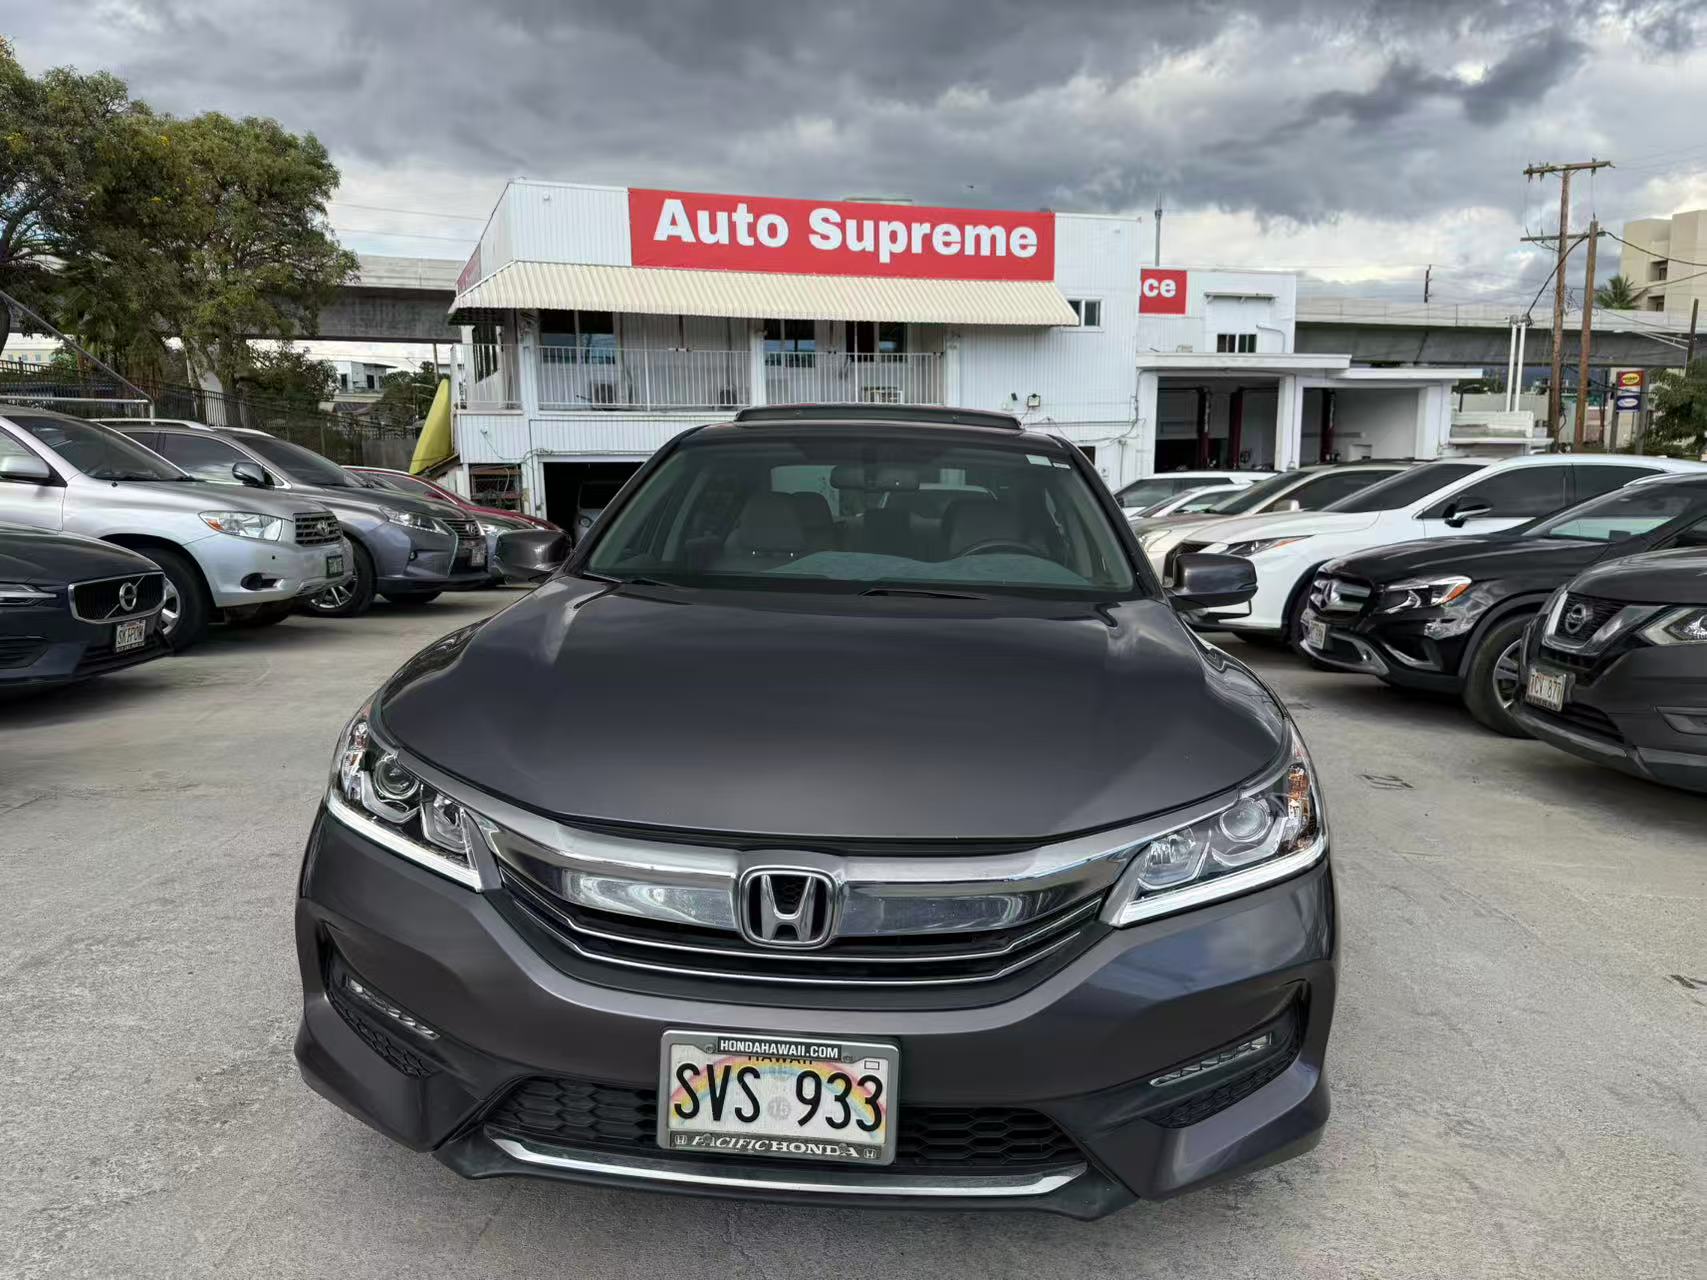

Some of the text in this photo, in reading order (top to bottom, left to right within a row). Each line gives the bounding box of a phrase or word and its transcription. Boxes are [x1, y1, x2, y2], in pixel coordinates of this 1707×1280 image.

[653, 198, 1038, 264] Auto Supreme
[720, 1040, 839, 1059] HONDAHAWAII.COM
[674, 1062, 883, 1132] SVS 933
[770, 1140, 860, 1158] HONDA
